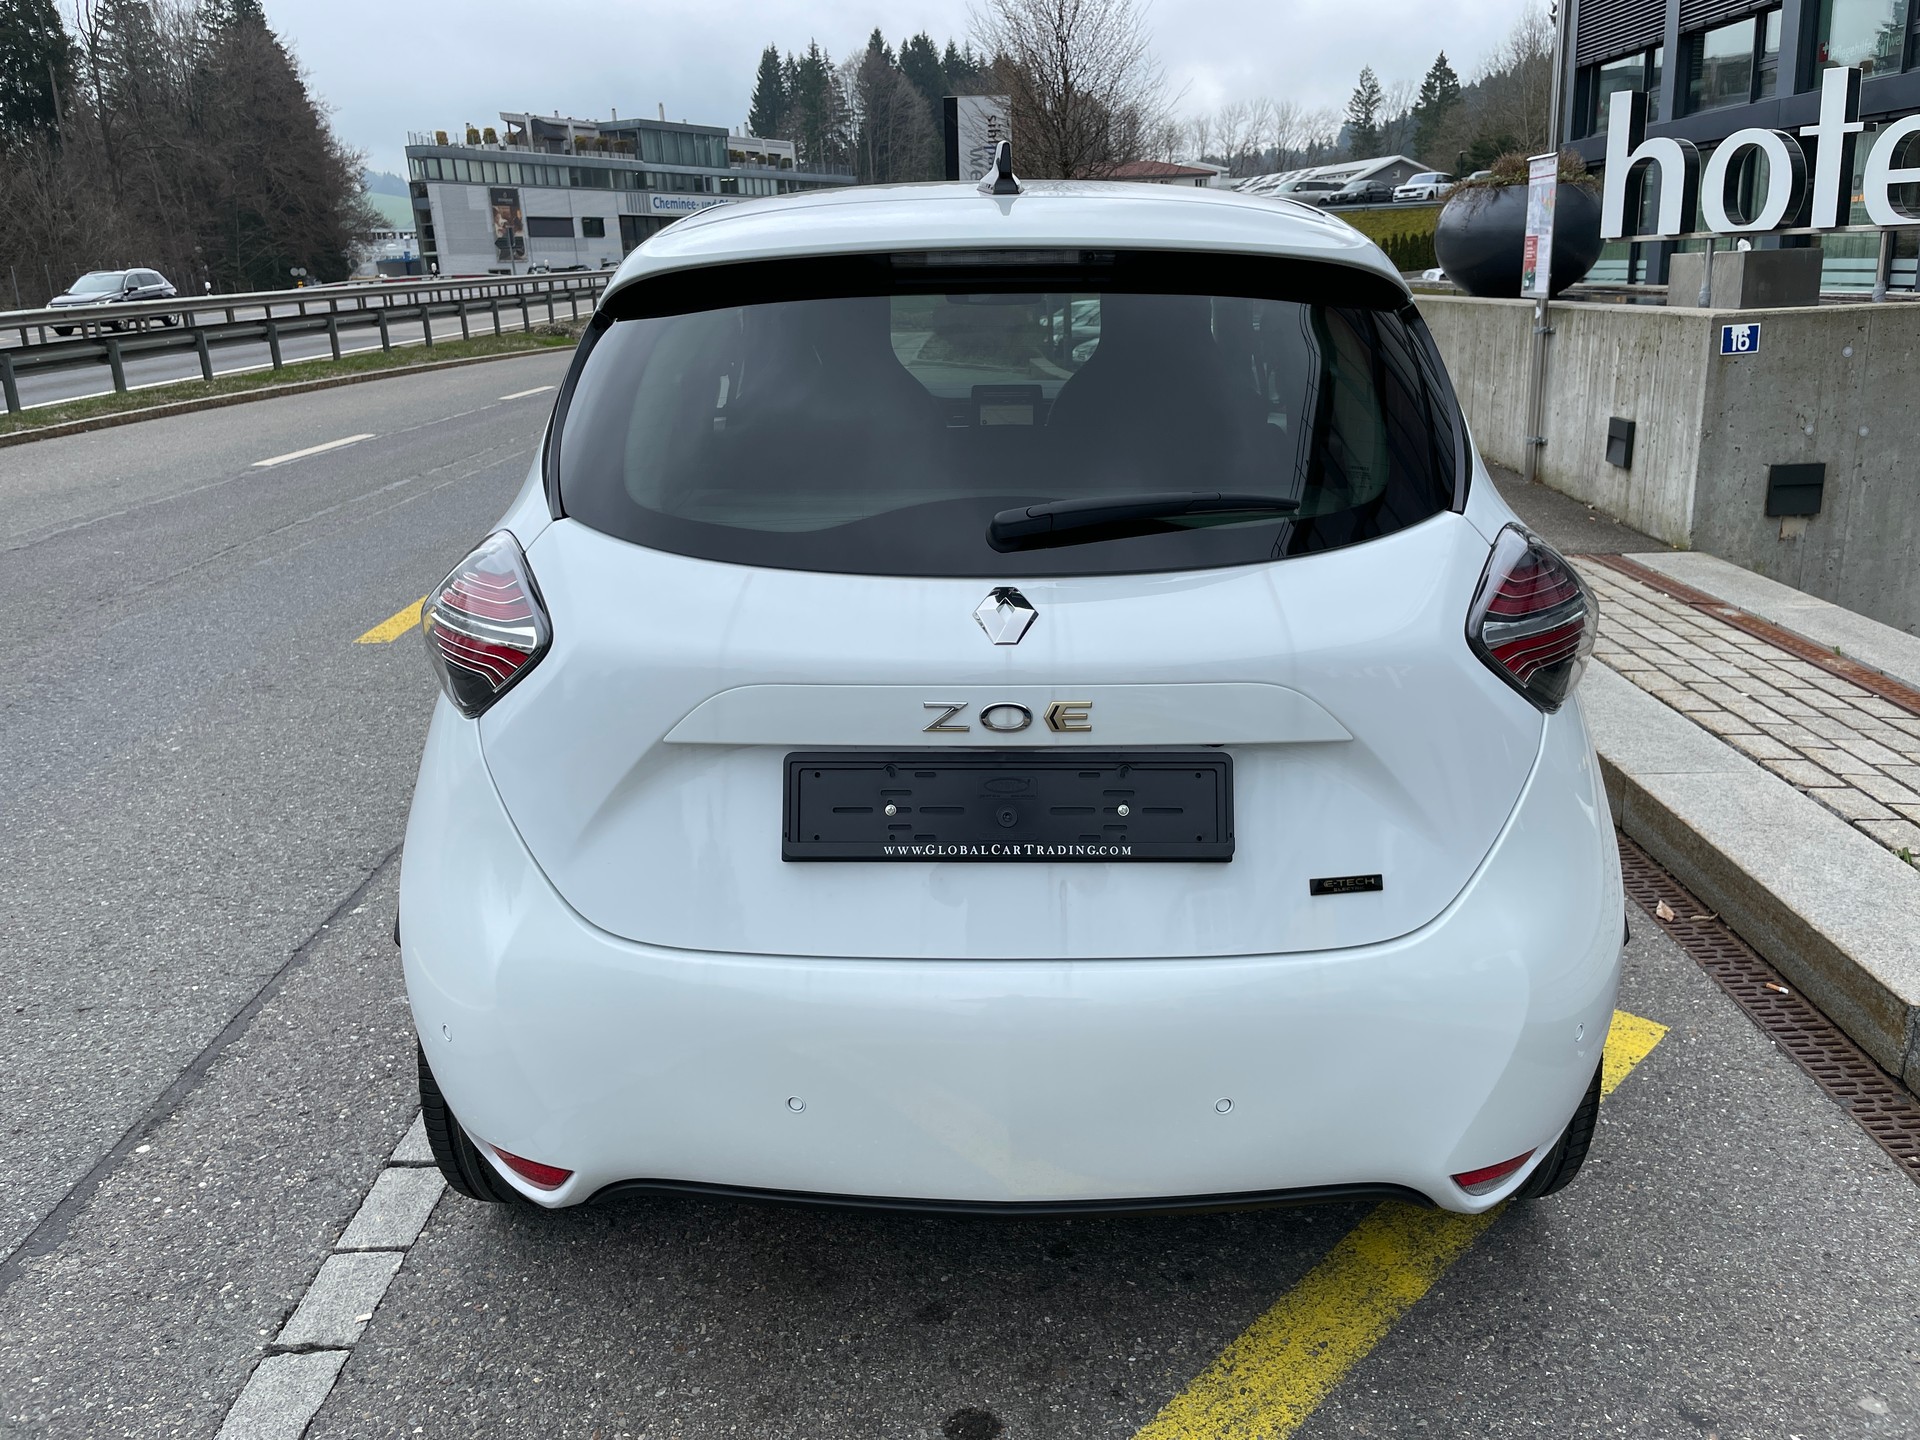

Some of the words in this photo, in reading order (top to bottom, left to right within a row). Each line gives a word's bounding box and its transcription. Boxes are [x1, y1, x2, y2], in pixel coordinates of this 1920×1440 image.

[970, 147, 984, 180] we
[1601, 67, 1920, 239] hote
[653, 197, 700, 210] Cheminée-
[922, 700, 1093, 732] ZOE
[1323, 877, 1375, 888] E-TECH
